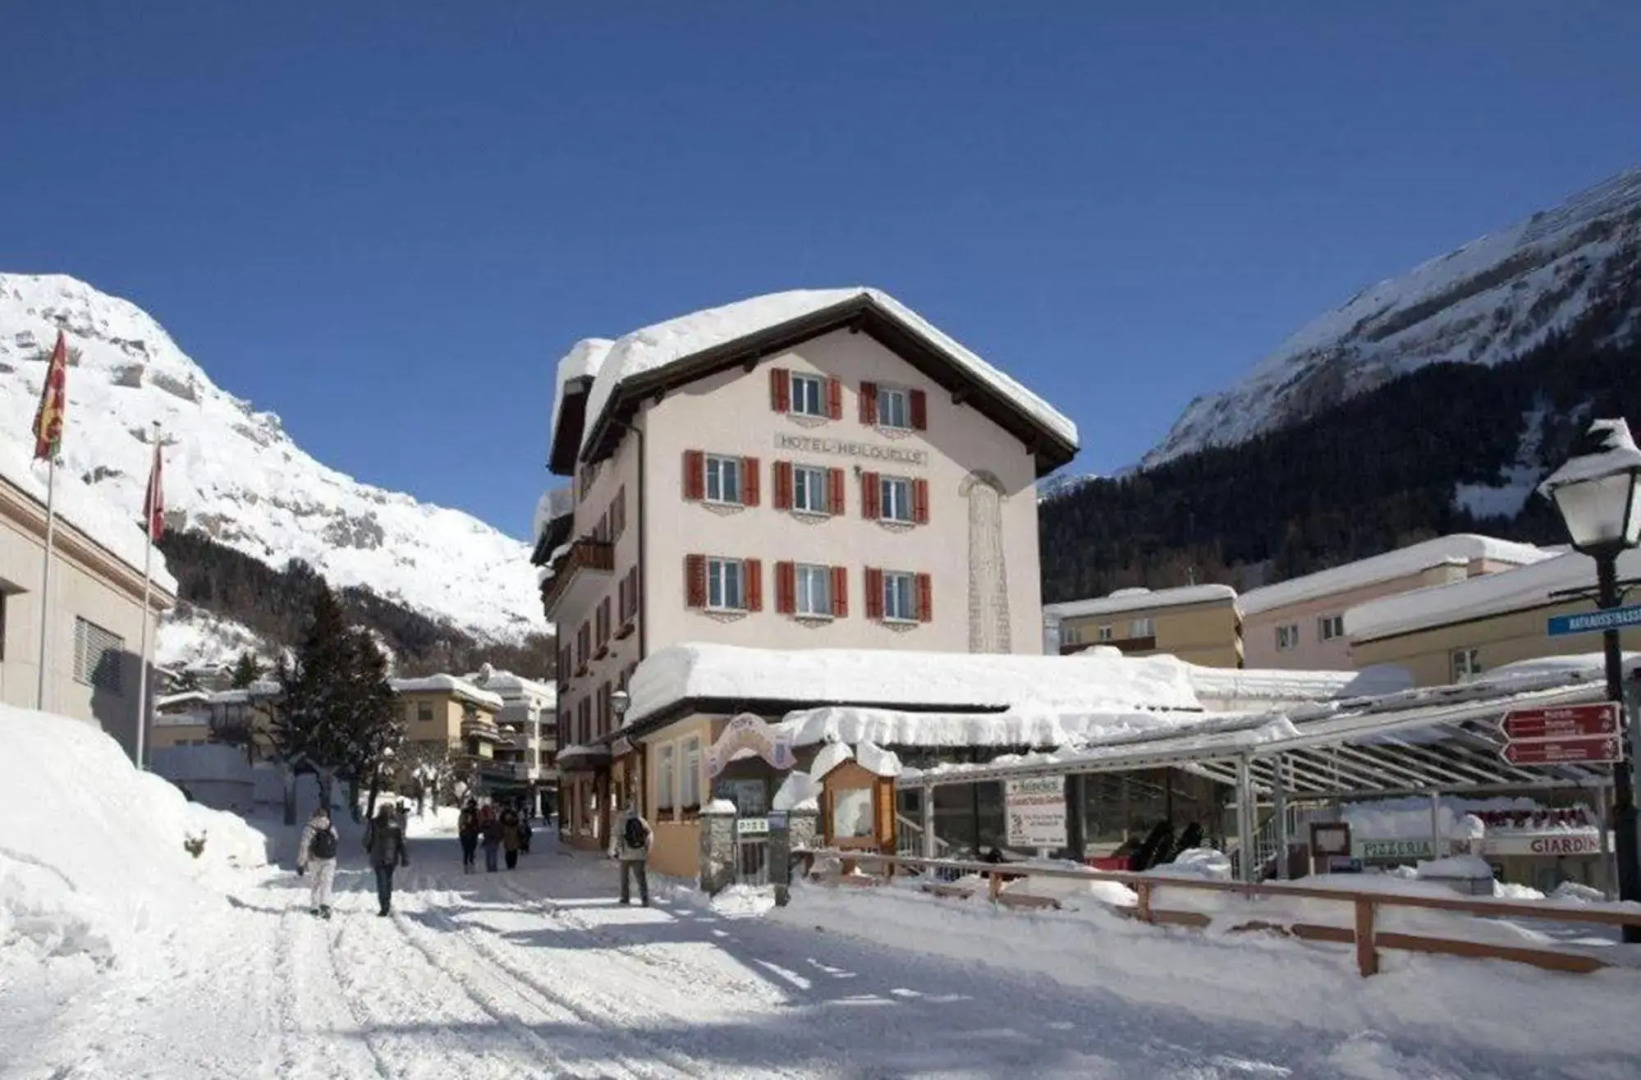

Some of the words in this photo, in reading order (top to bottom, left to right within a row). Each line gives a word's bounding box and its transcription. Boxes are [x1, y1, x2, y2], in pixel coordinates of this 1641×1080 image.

[781, 435, 831, 453] HOTEL
[1363, 840, 1432, 856] PIZZERIA
[1530, 838, 1600, 854] GIARDIN
